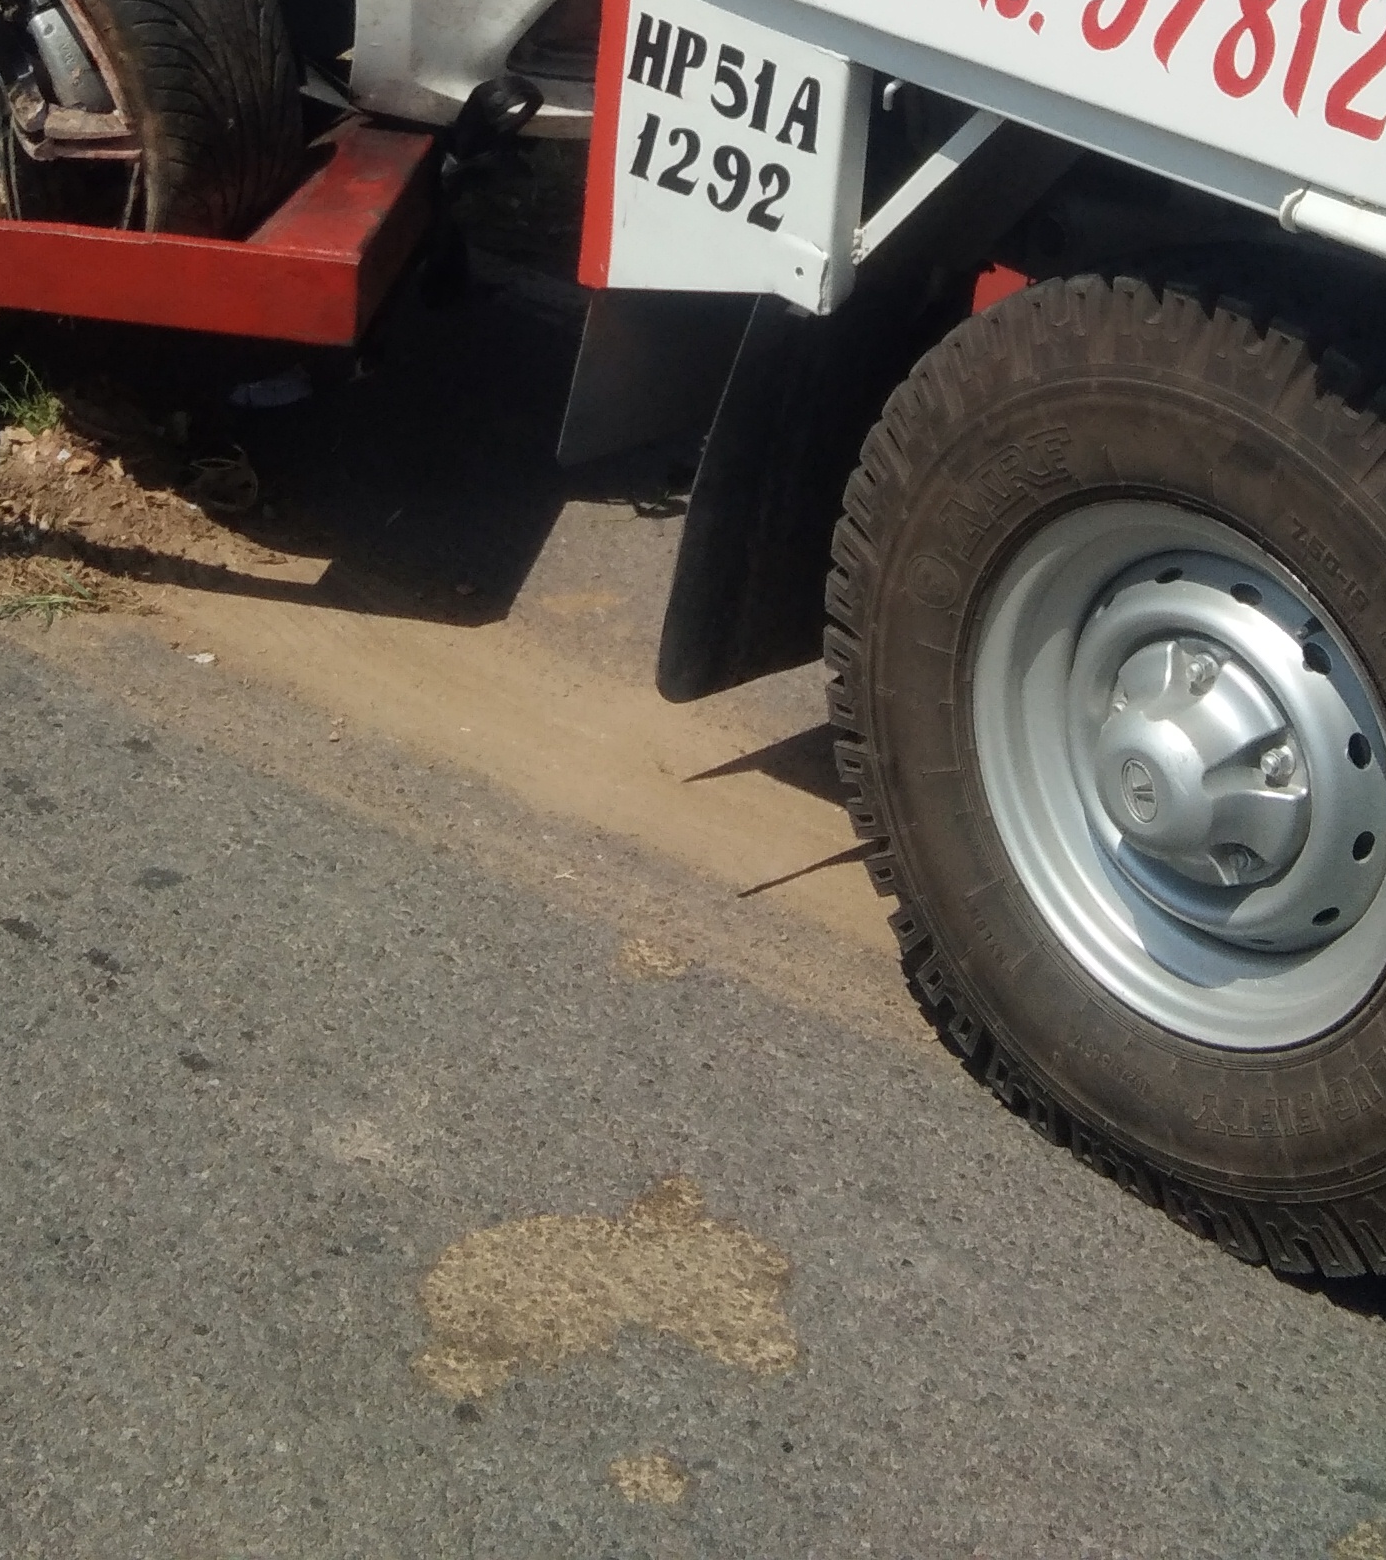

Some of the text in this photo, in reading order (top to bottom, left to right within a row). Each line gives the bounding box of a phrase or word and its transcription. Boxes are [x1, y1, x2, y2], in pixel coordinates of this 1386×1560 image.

[629, 113, 791, 233] 1292
[938, 426, 1072, 561] MRF
[1193, 1092, 1322, 1139] FIFTY
